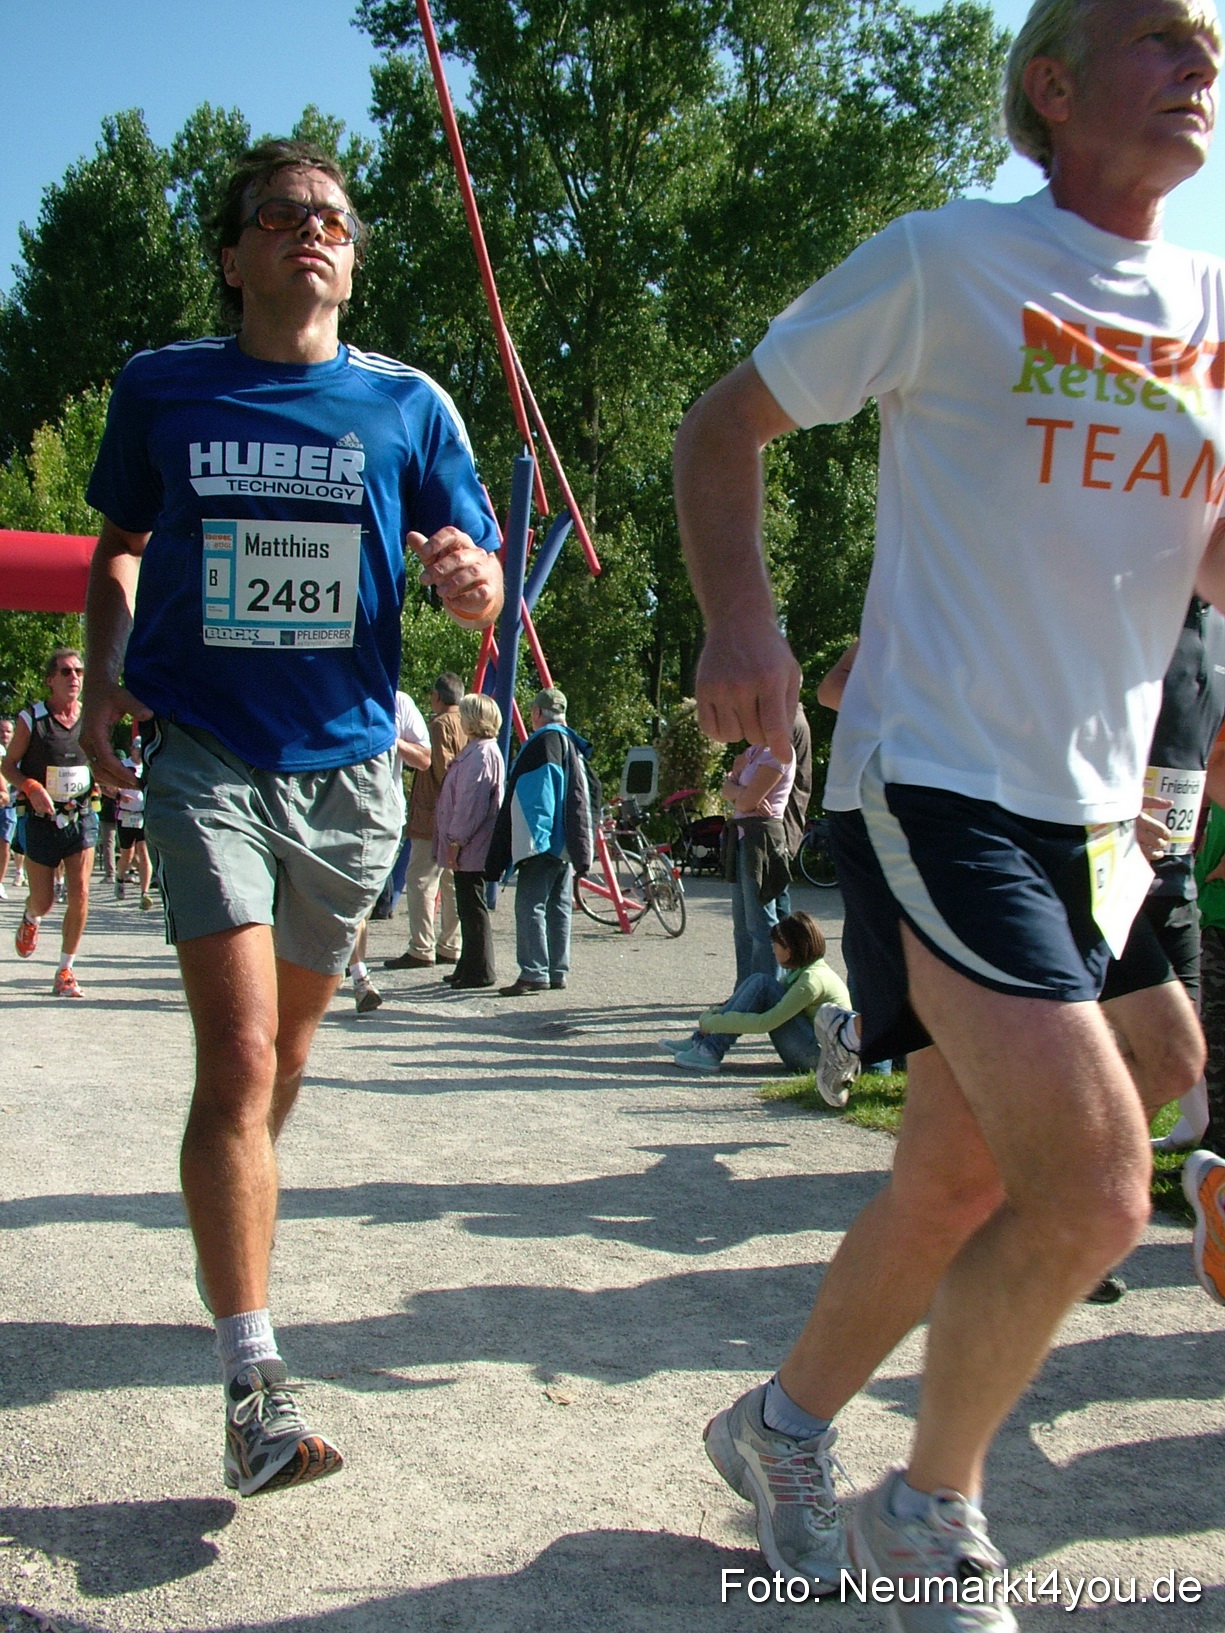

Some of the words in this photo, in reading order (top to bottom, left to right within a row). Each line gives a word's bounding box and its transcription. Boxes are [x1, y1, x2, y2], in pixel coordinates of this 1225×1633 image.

[1011, 345, 1208, 417] Reisen
[189, 441, 366, 485] HUBER
[226, 479, 356, 500] TECHNOLOGY
[245, 532, 330, 559] Matthias
[209, 569, 218, 586] B
[247, 578, 341, 613] 2481
[204, 627, 260, 640] BOCK
[297, 629, 351, 640] PFLEIDERER
[64, 782, 83, 792] 120
[1165, 808, 1194, 831] 629
